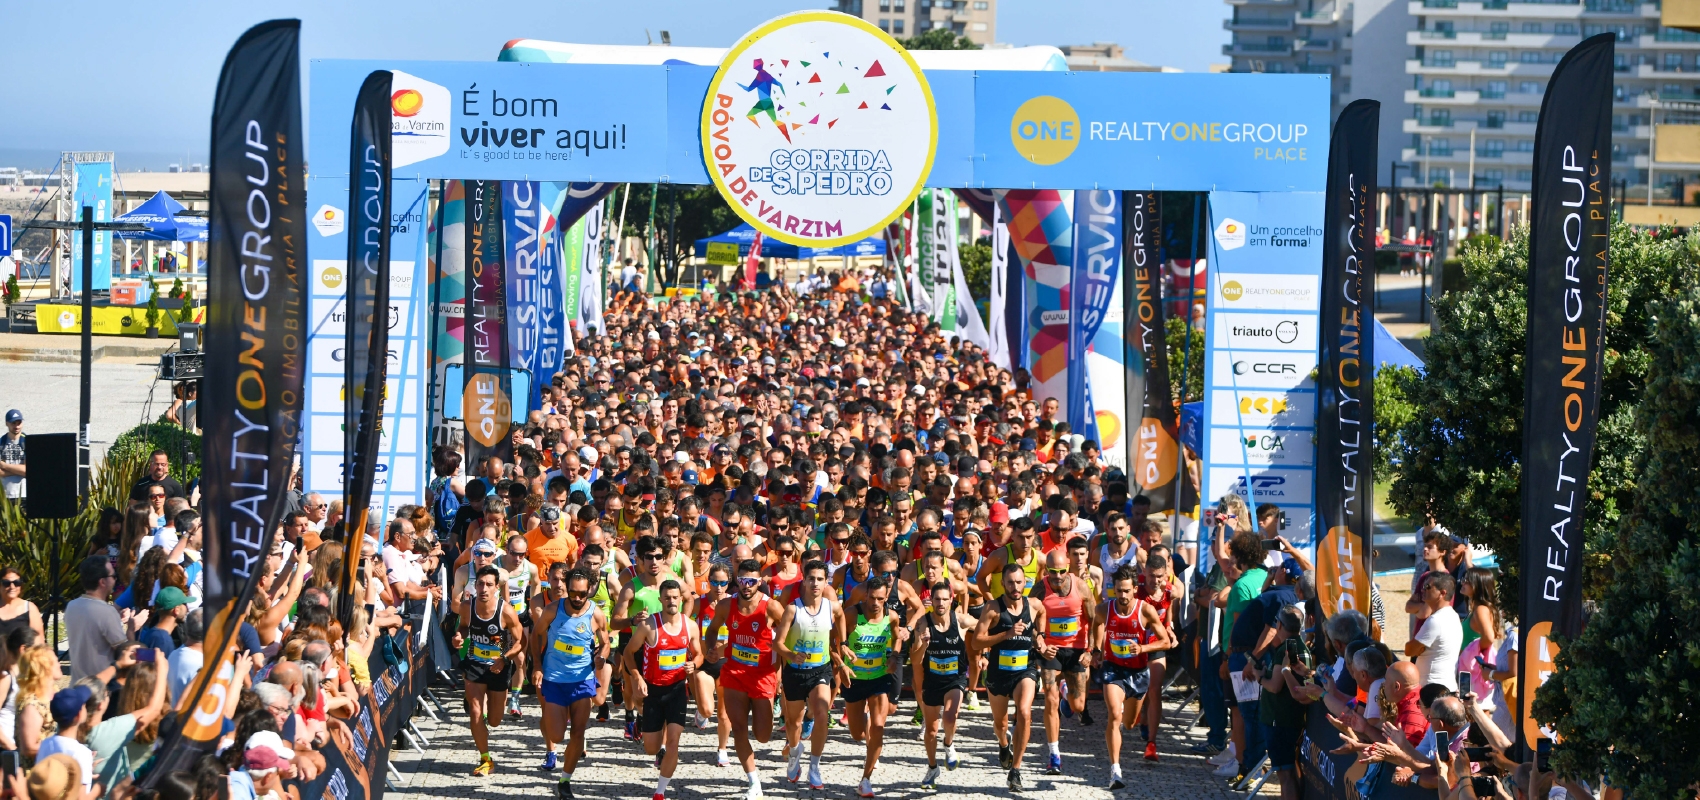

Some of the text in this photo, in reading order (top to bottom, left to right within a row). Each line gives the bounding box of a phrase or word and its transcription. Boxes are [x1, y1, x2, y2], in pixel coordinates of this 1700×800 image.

[463, 82, 558, 118] É bom
[409, 120, 444, 131] Varzim
[1017, 120, 1074, 141] ONE
[460, 122, 627, 156] viver aqui!
[483, 149, 510, 162] good
[513, 150, 525, 160] to
[529, 150, 542, 160] be
[545, 150, 572, 161] here!
[770, 149, 892, 172] CORRIDA
[1254, 147, 1307, 161] PLACE
[712, 93, 737, 178] PÓVOA
[728, 176, 758, 206] DE
[758, 199, 843, 238] VARZIM
[750, 167, 893, 196] DE S.PEDRO
[391, 211, 421, 222] celho
[390, 223, 410, 234] ma!
[1250, 225, 1323, 236] Um concelho
[1250, 235, 1311, 247] em forma!
[708, 251, 737, 262] CORRIDA
[567, 274, 578, 315] moving
[1223, 287, 1241, 295] ONE
[1233, 325, 1273, 337] triauto
[1253, 363, 1297, 373] CCR
[476, 381, 495, 440] ONE
[1260, 436, 1285, 451] CA
[1141, 424, 1159, 484] ONE
